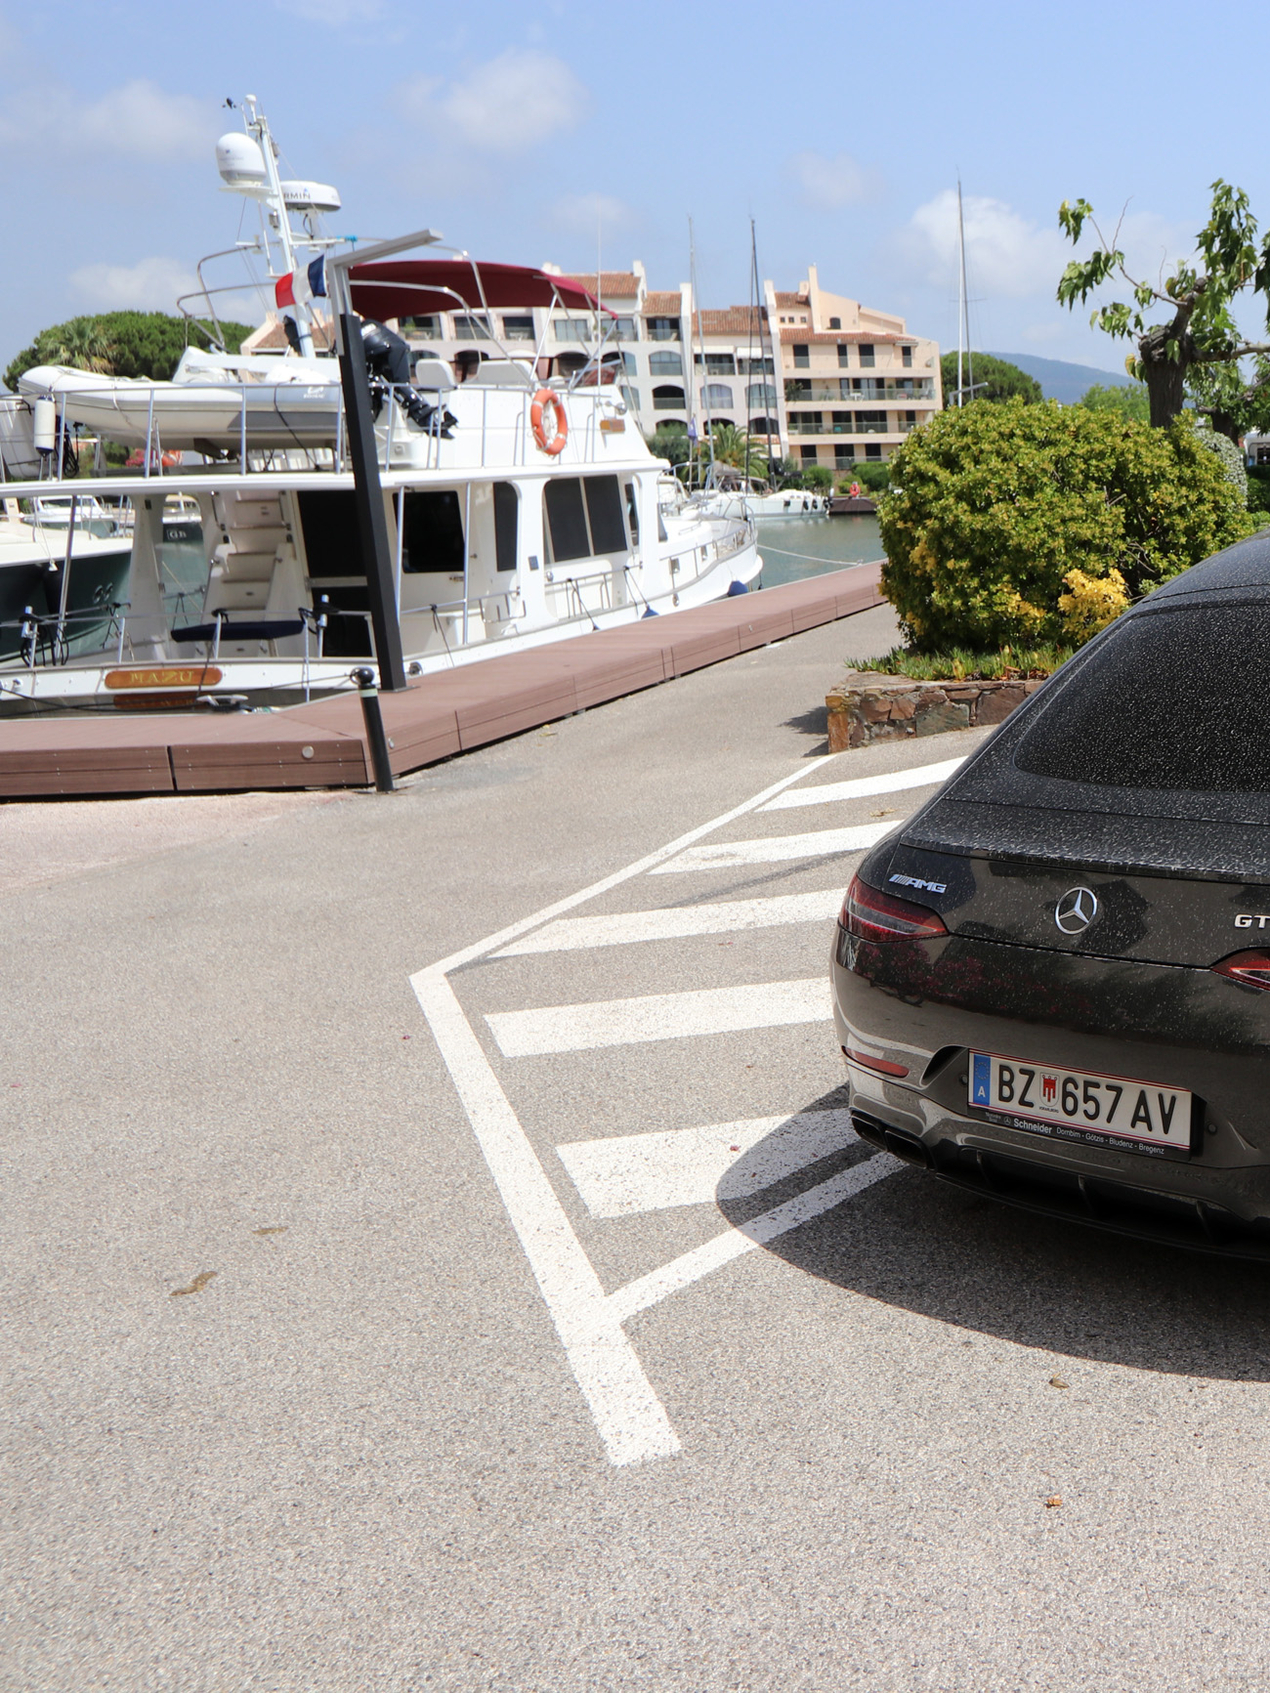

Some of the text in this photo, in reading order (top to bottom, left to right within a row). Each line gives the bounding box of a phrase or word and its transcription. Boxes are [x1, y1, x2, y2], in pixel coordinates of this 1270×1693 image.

[282, 192, 311, 200] RMIN
[130, 671, 195, 683] MAZU
[905, 876, 947, 893] AMG
[977, 1086, 986, 1097] A
[998, 1064, 1176, 1135] BZ 657 AV
[1013, 1117, 1052, 1134] Schneider
[1109, 1137, 1133, 1149] Bludenz
[1138, 1143, 1165, 1154] Bregenz
